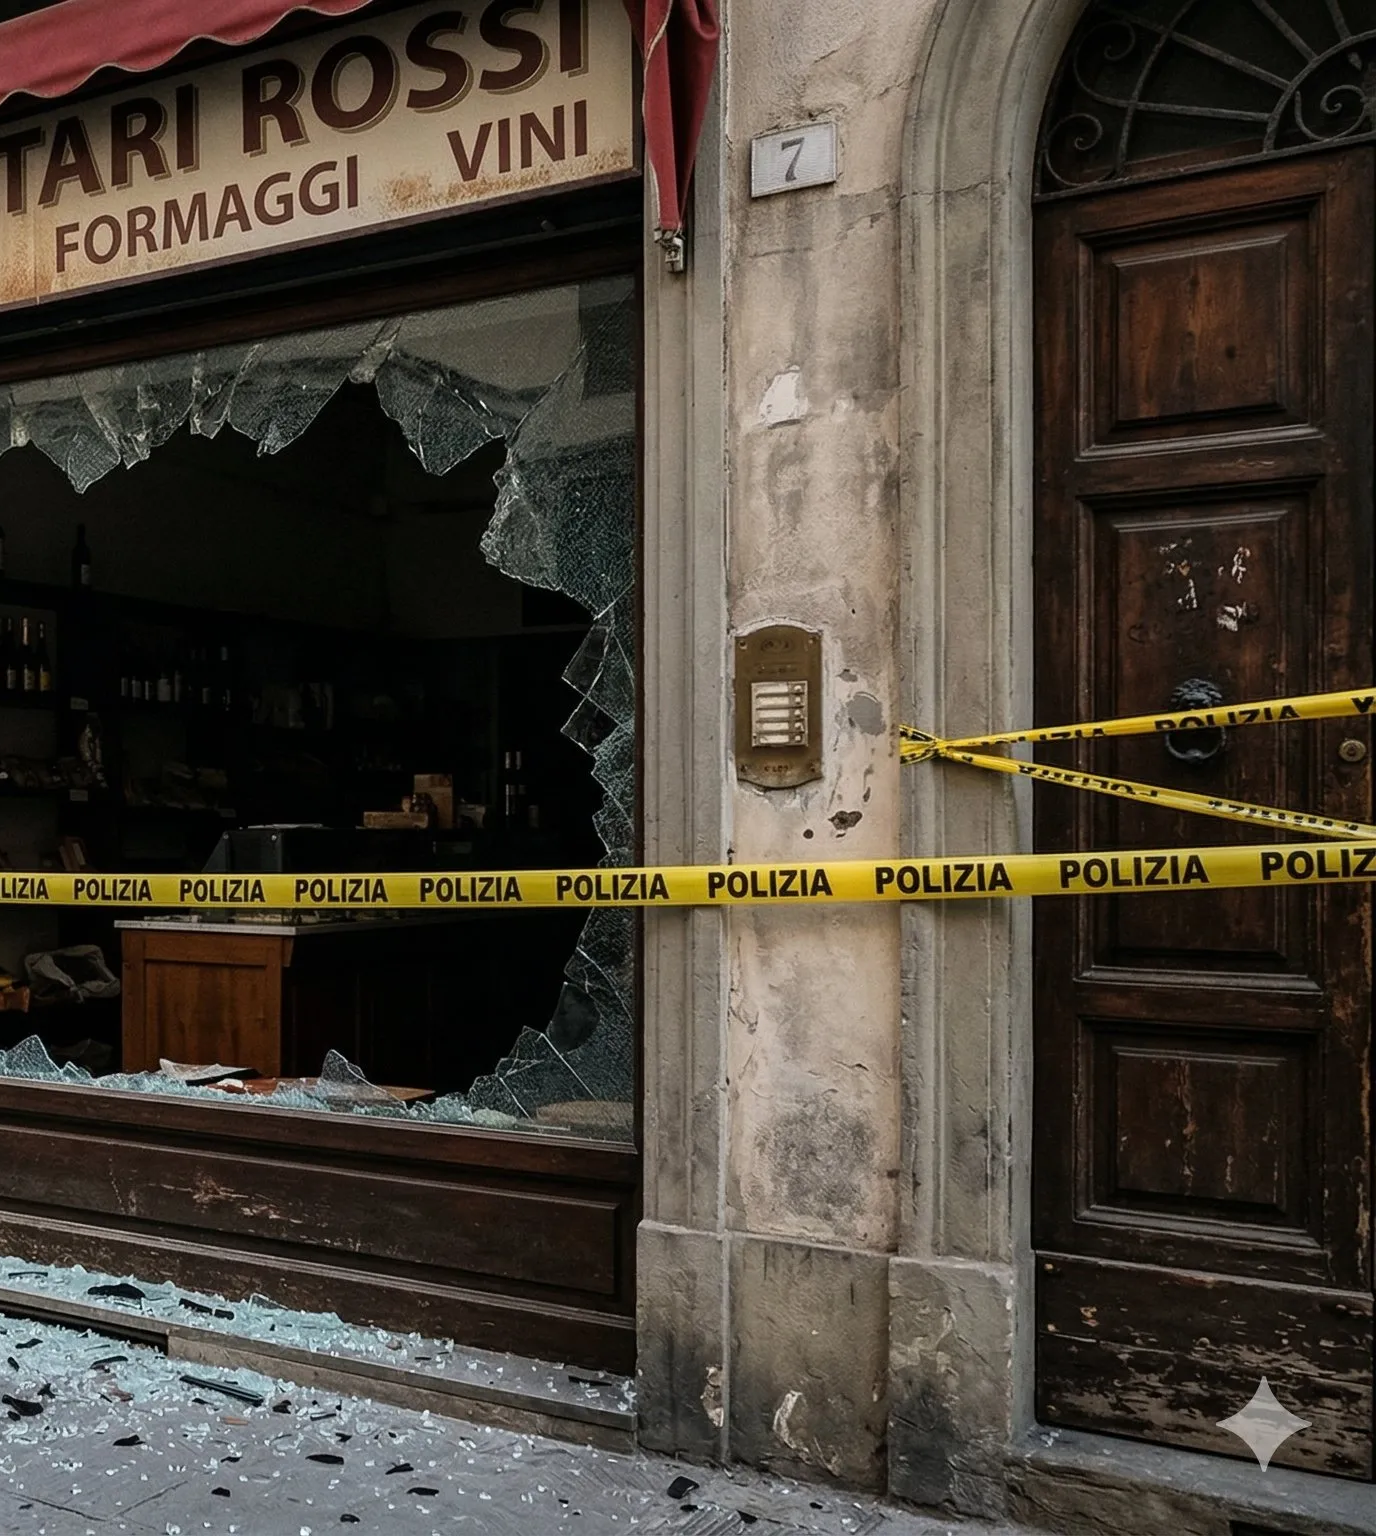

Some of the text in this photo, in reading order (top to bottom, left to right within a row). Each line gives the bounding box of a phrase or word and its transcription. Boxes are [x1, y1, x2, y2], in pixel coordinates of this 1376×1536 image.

[241, 0, 589, 157] ROSSI
[55, 155, 359, 274] FORMAGGI
[446, 99, 588, 182] VINI
[781, 137, 805, 182] 7
[75, 878, 153, 902] POLIZIA
[180, 879, 266, 903] POLIZIA
[295, 878, 389, 903] POLIZIA
[420, 876, 523, 903] POLIZIA
[556, 873, 669, 900] POLIZIA
[708, 868, 833, 898] POLIZIA
[875, 863, 1013, 894] POLIZIA
[1059, 855, 1210, 888] POLIZIA
